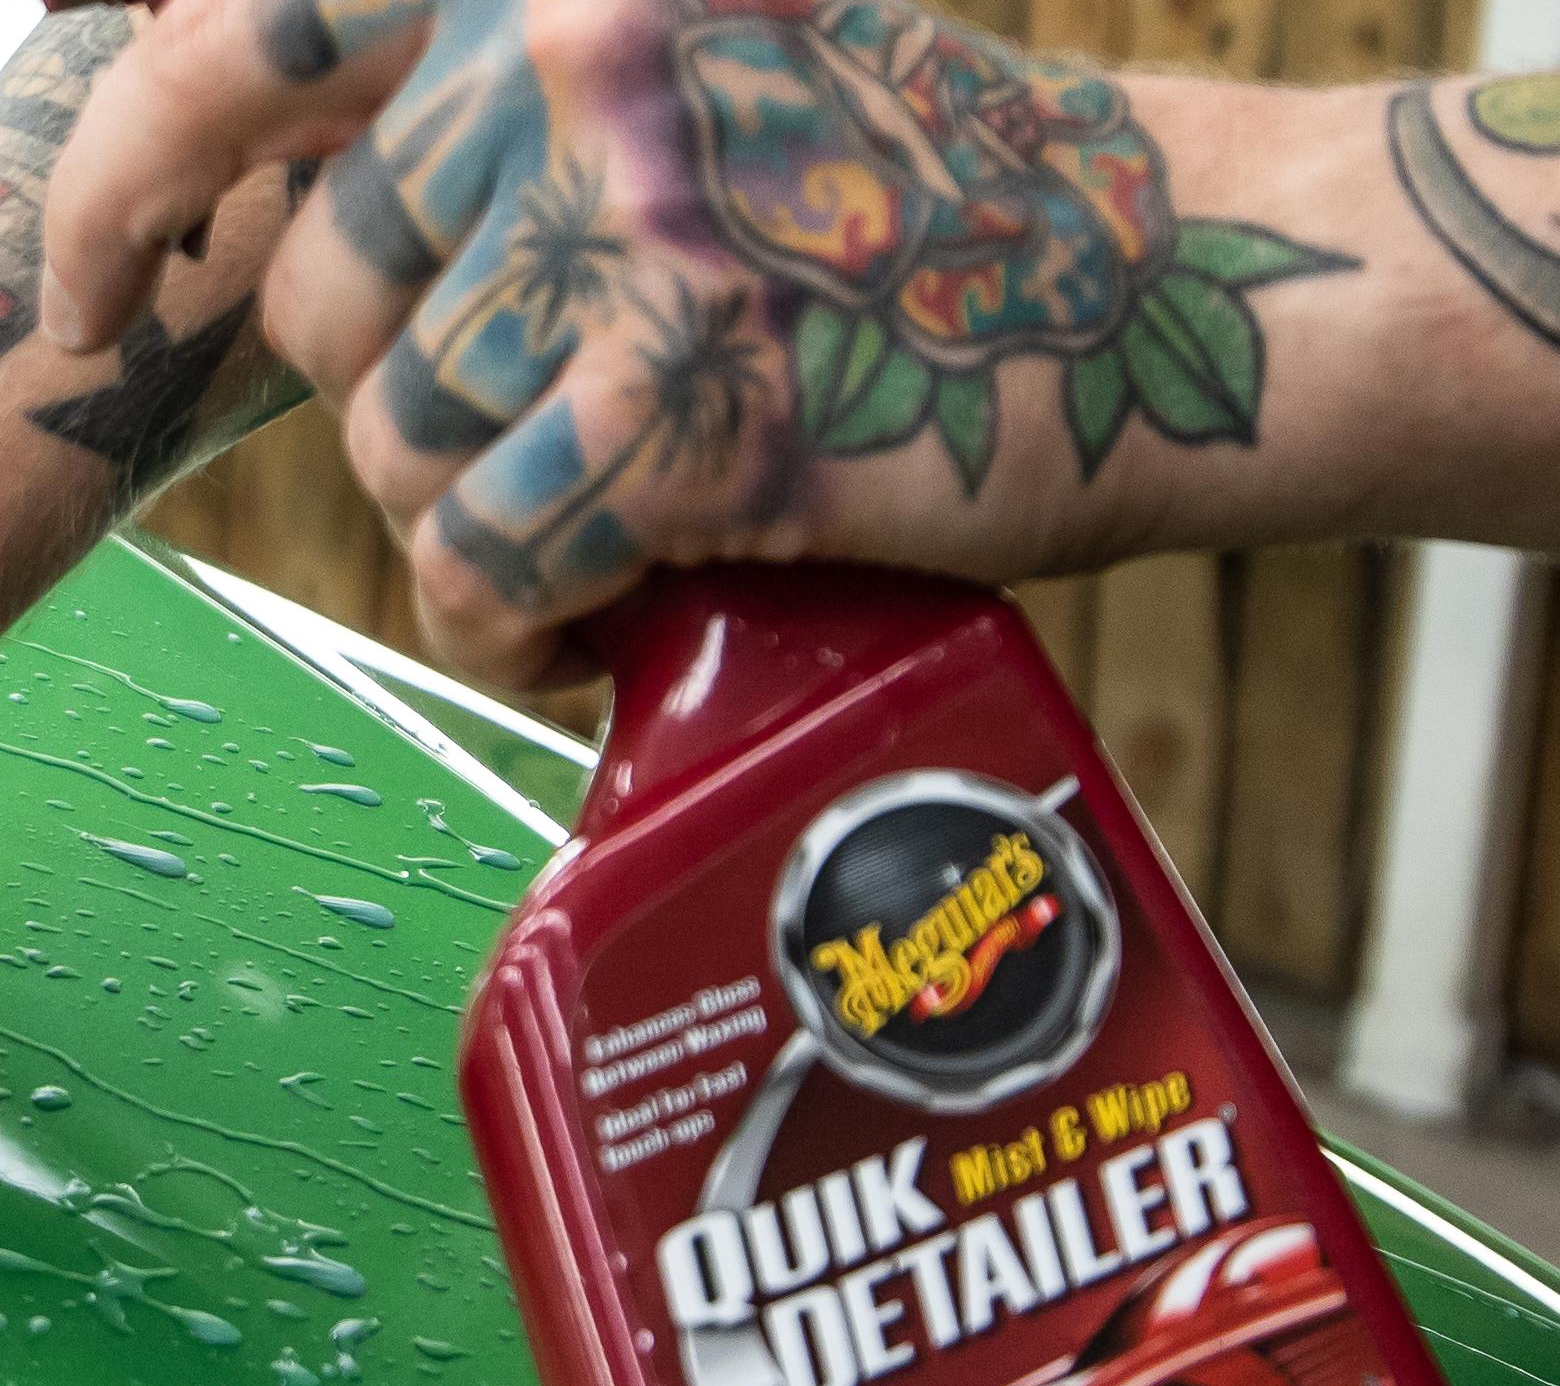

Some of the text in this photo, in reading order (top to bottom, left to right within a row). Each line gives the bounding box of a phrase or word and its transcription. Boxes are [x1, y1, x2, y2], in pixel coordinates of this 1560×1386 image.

[809, 830, 1046, 1039] Meguiar's
[580, 1004, 768, 1098] Between Waxing
[950, 1070, 1192, 1206] Mist & Wipe
[655, 1134, 947, 1329] QUIK
